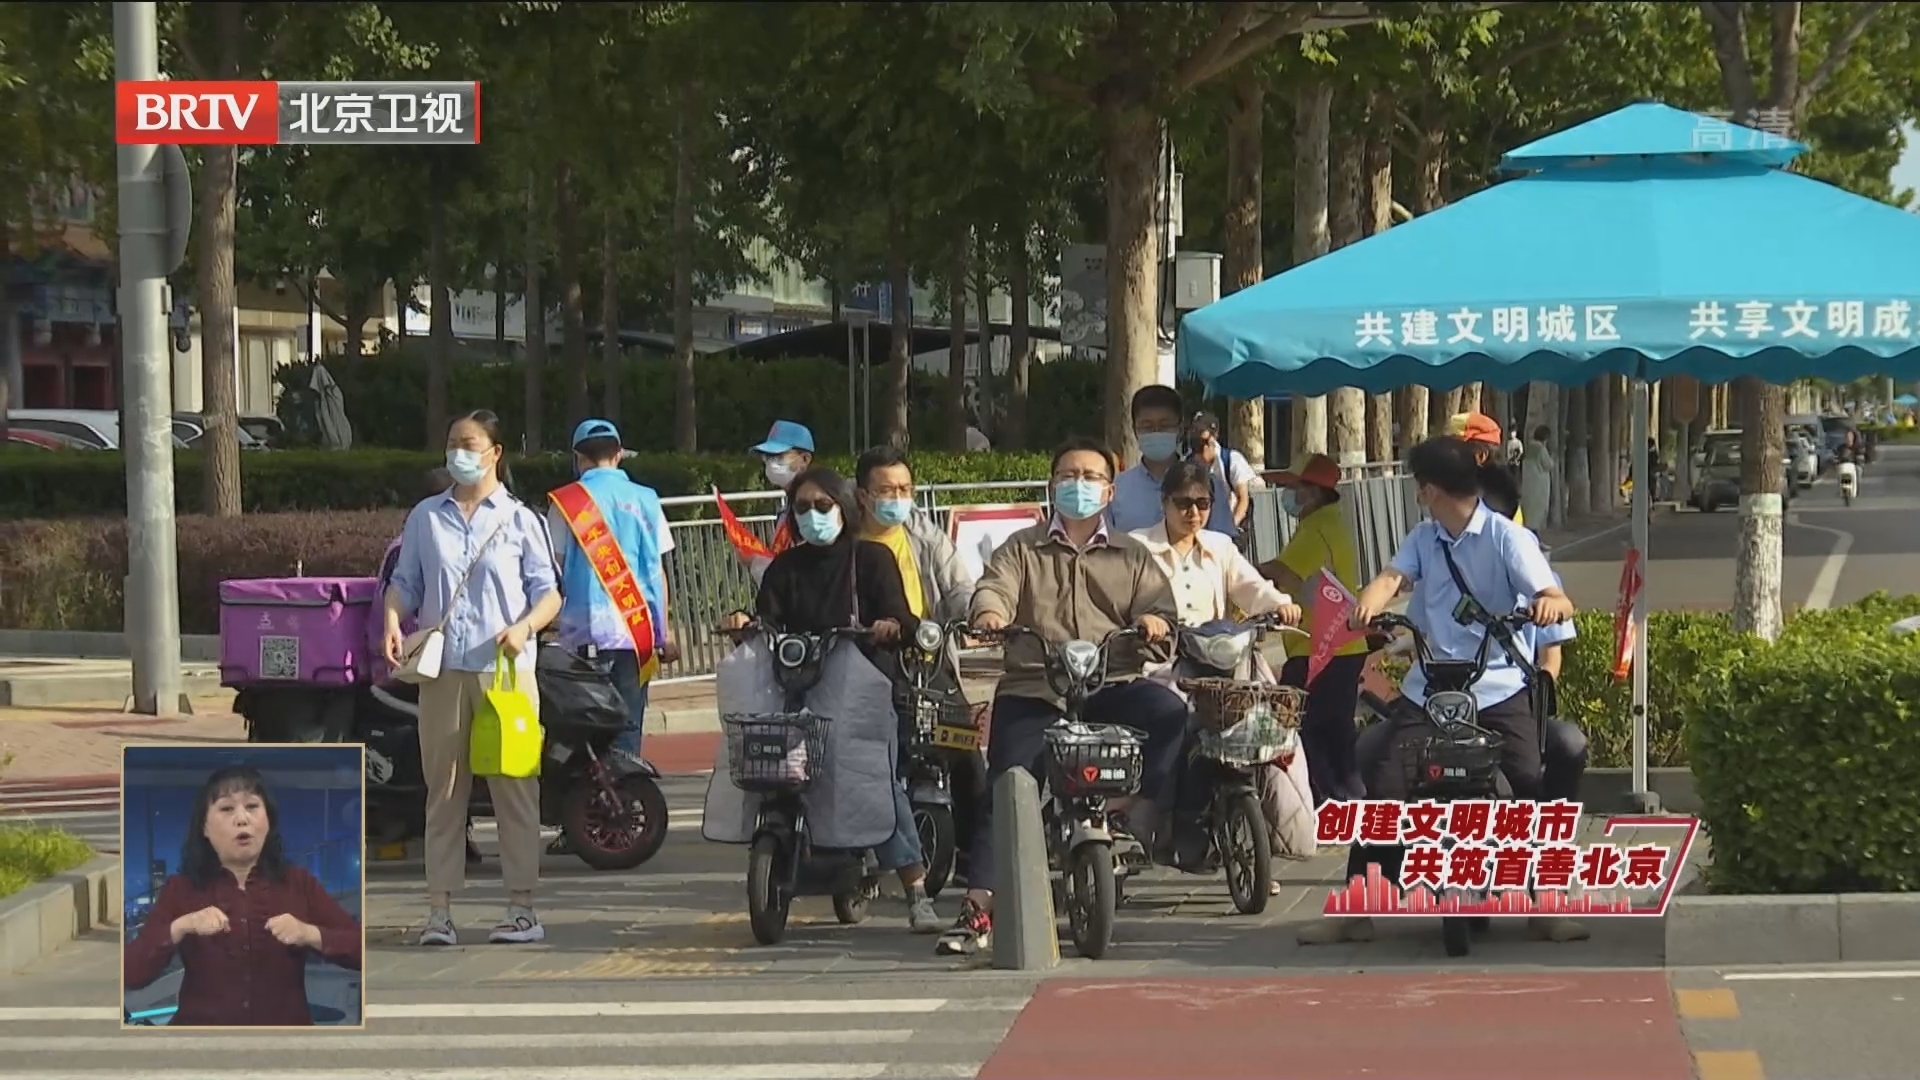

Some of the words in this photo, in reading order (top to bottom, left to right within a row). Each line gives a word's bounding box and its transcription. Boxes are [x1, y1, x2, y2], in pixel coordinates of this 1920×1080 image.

[1354, 304, 1621, 348] 共建文明城区
[1689, 299, 1920, 340] 共享文明成
